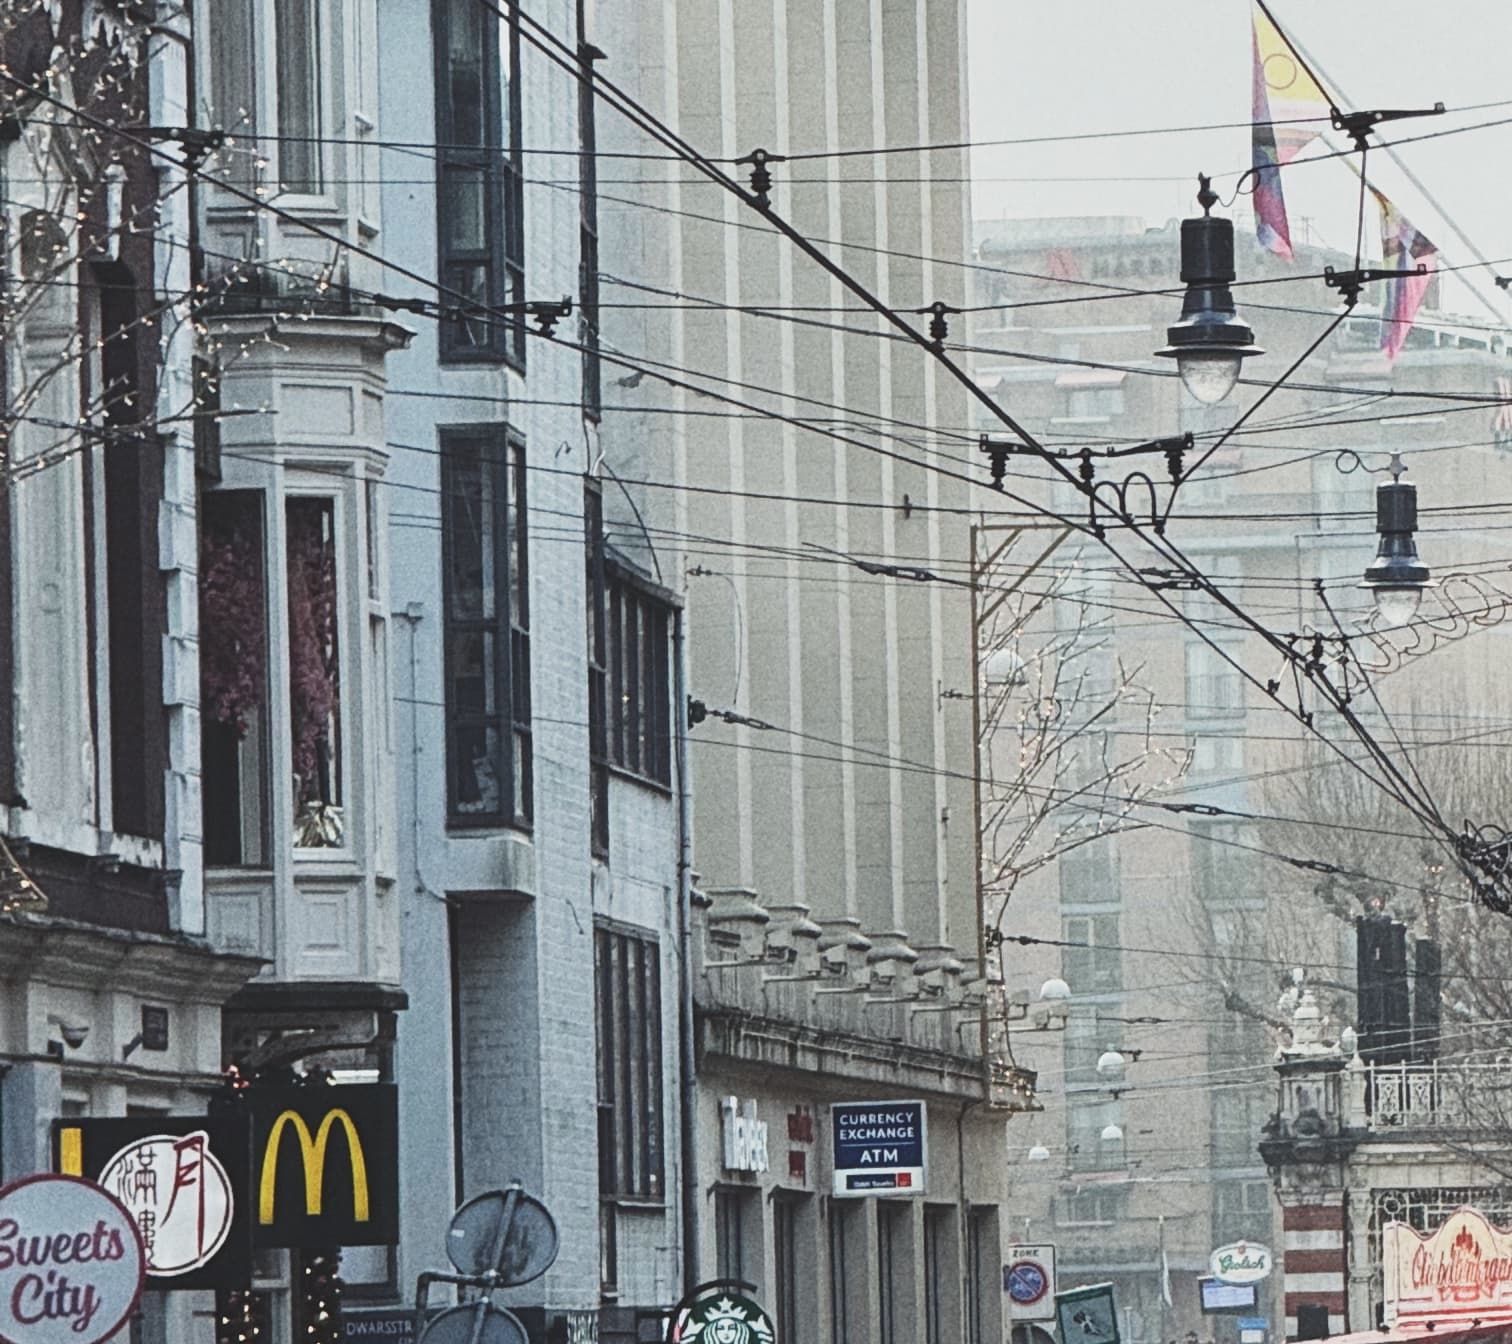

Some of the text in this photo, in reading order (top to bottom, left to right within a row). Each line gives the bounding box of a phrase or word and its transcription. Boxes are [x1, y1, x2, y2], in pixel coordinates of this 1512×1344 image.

[839, 1112, 914, 1126] CURRENCY
[839, 1127, 915, 1140] EXCHANGE
[860, 1148, 899, 1164] ATM
[0, 1217, 125, 1271] Sweets
[1012, 1249, 1040, 1258] ZONE
[1219, 1255, 1265, 1272] Grolsch
[11, 1269, 101, 1333] City
